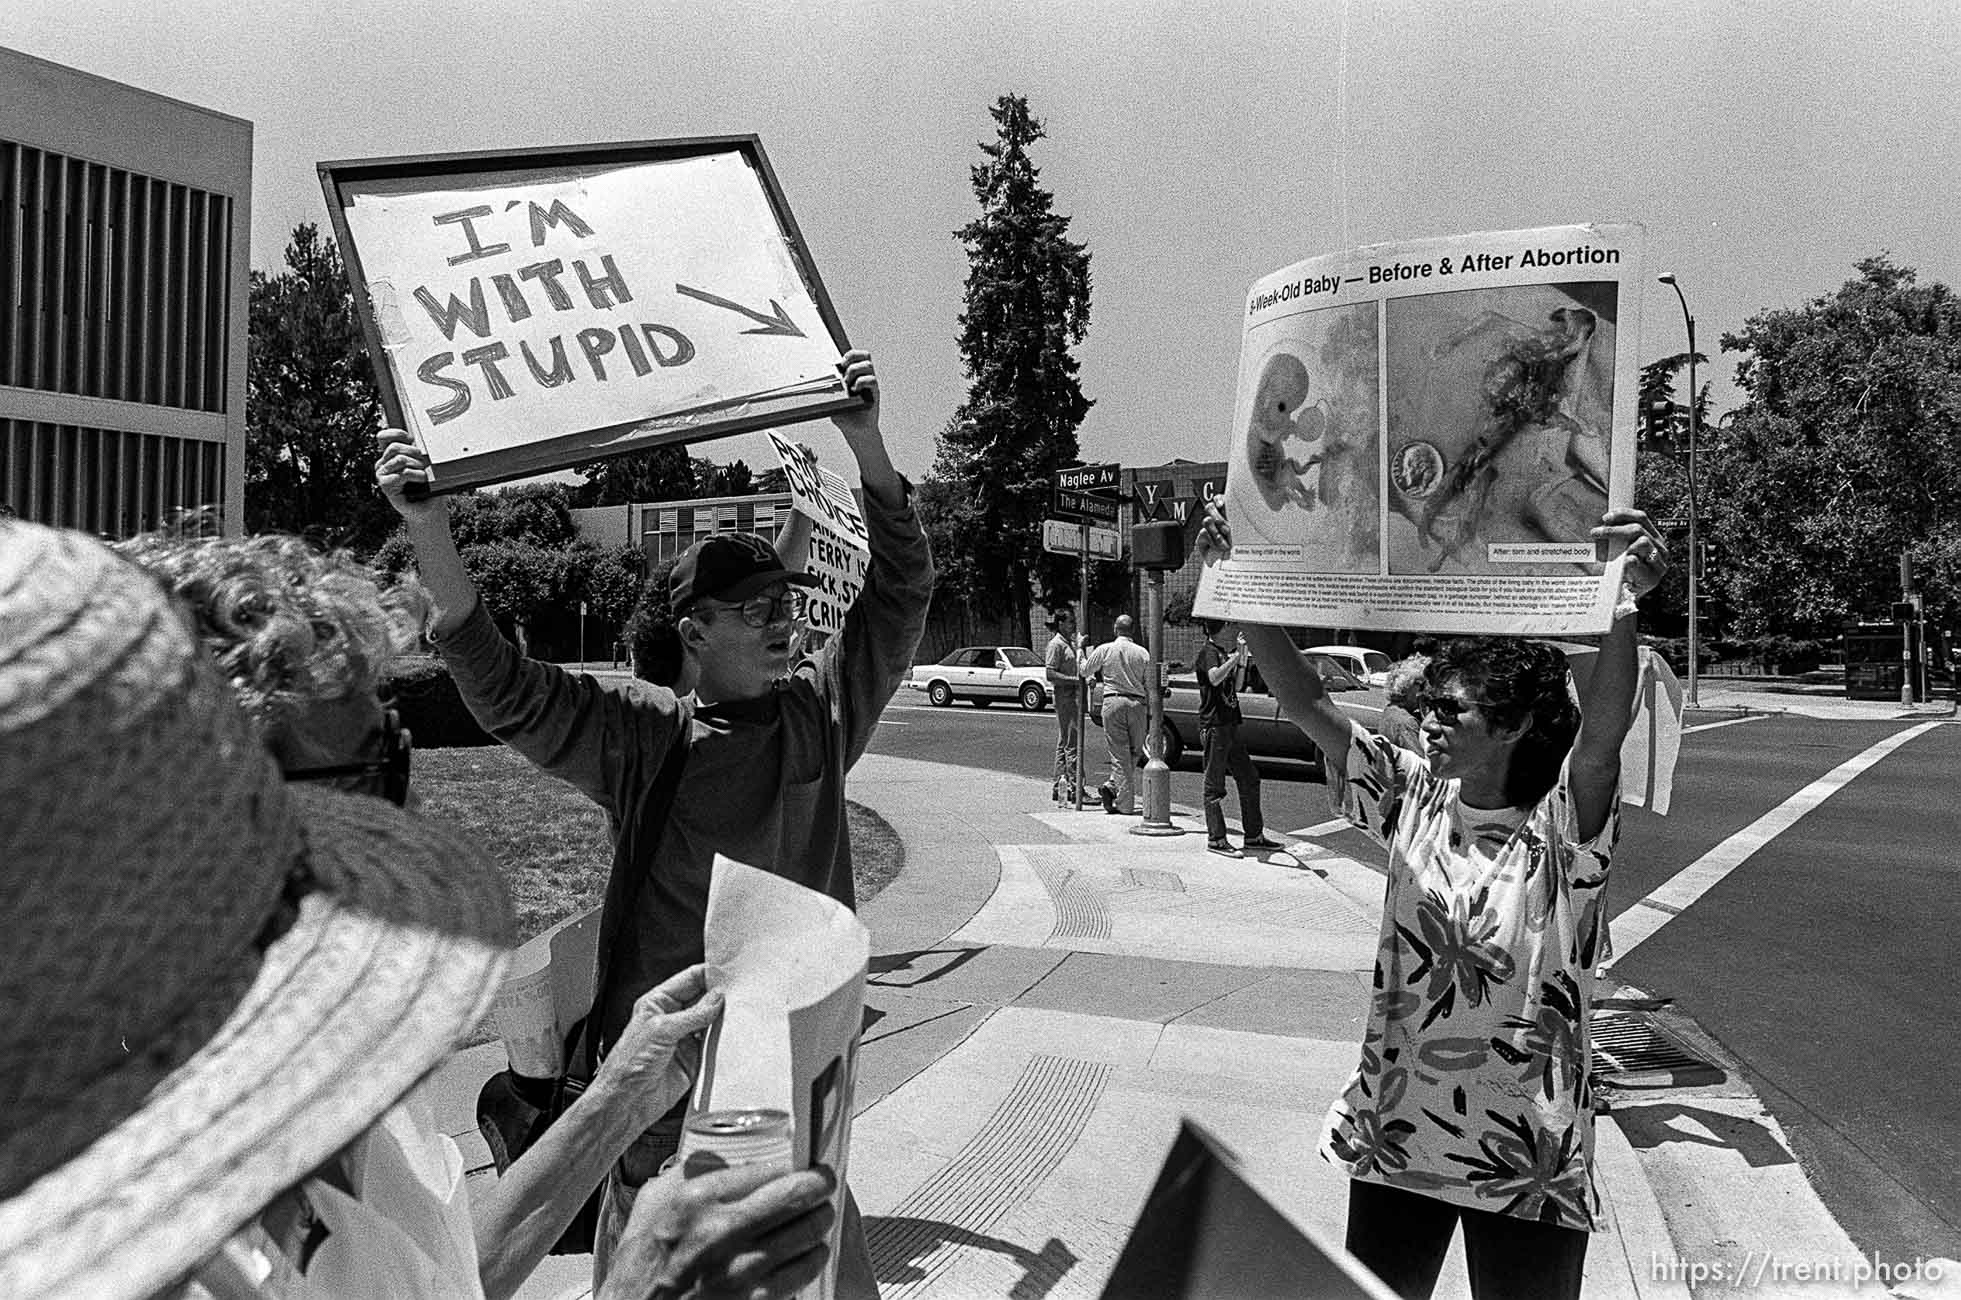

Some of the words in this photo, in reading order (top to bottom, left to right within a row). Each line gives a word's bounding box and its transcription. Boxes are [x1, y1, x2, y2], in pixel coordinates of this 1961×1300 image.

[433, 198, 595, 266] I'M
[413, 254, 634, 341] WITH
[1304, 274, 1341, 296] Baby
[1368, 262, 1432, 284] Before
[1439, 258, 1454, 275] &
[1460, 251, 1514, 273] After
[1519, 244, 1620, 268] Abortion
[416, 323, 697, 425] STUPID
[768, 432, 821, 488] PRO
[1060, 473, 1095, 489] Naglee
[1100, 470, 1114, 483] Av
[785, 464, 869, 541] CHOICE
[1060, 493, 1077, 509] The
[809, 537, 851, 573] TERRY
